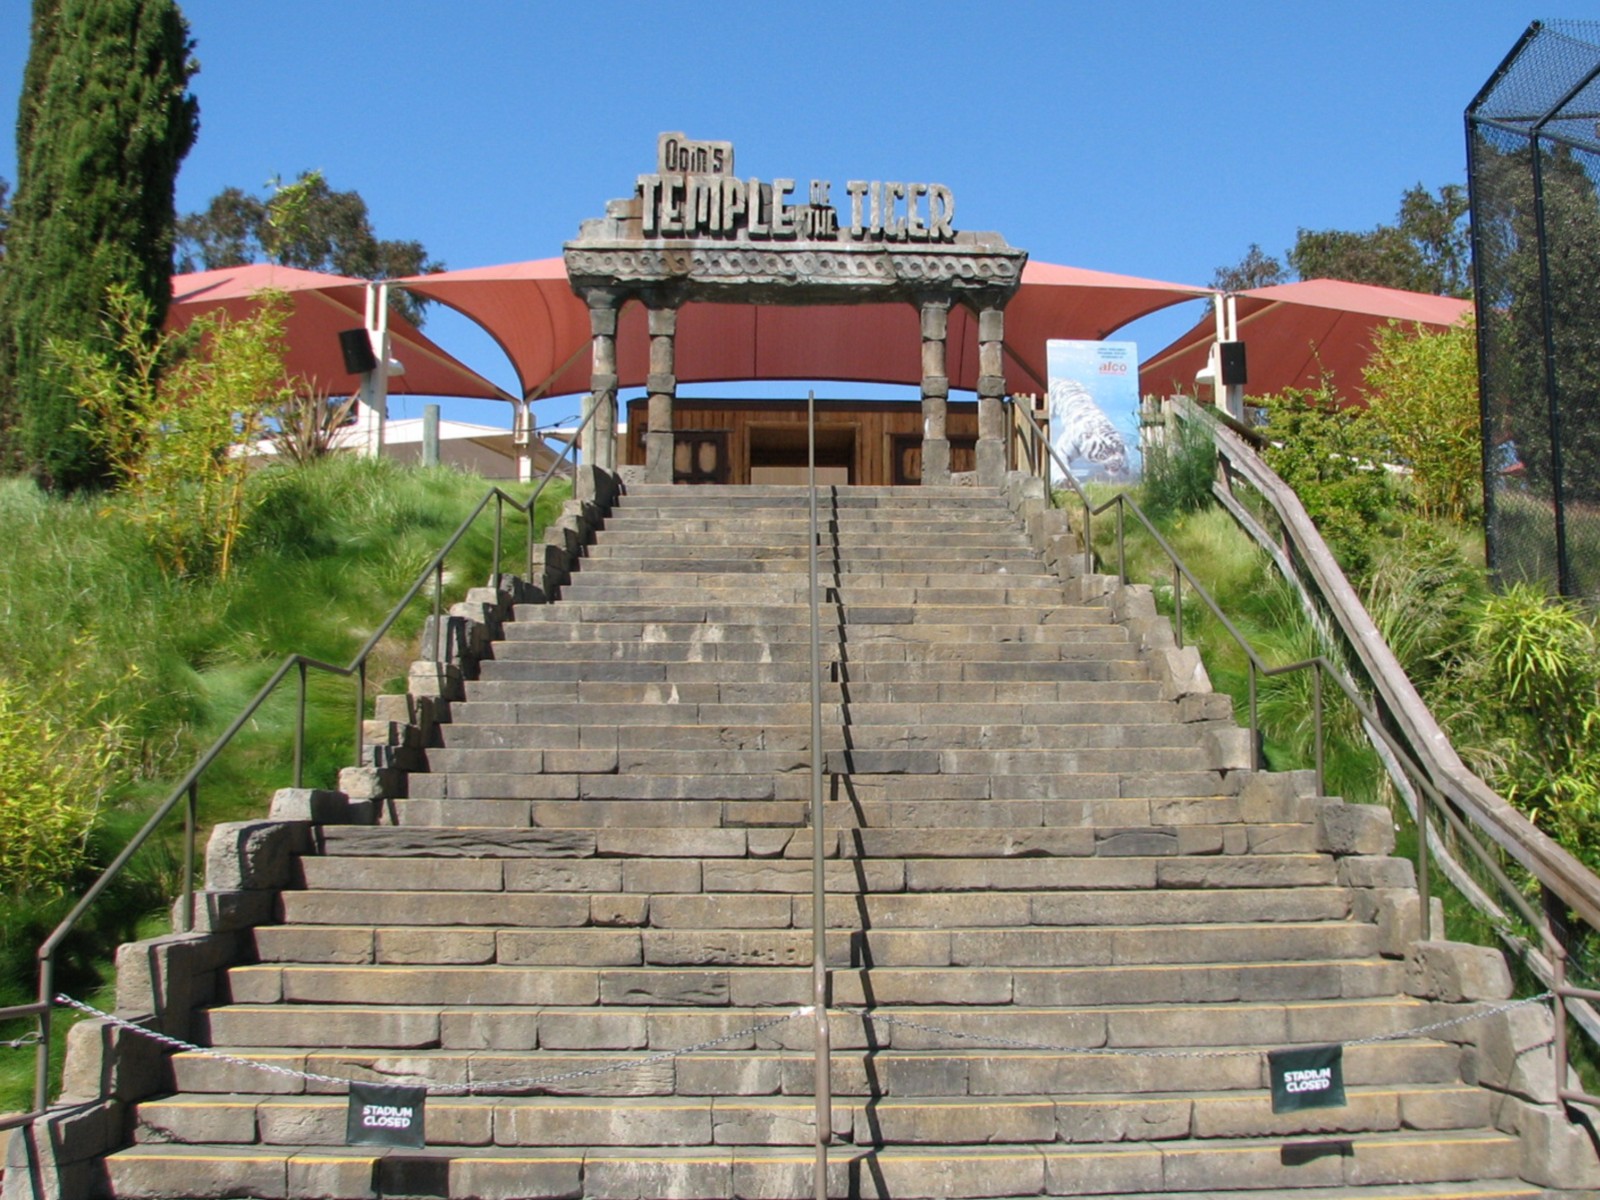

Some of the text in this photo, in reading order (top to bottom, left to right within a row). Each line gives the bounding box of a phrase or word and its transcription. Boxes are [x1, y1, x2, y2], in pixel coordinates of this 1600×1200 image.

[638, 174, 797, 239] TEMPLE
[806, 208, 839, 240] THE
[847, 180, 955, 243] TIGER
[1283, 1067, 1331, 1082] STADIUM
[1286, 1078, 1330, 1092] CLOSED
[363, 1104, 413, 1117] STADIUM
[363, 1115, 411, 1128] CLOSED
